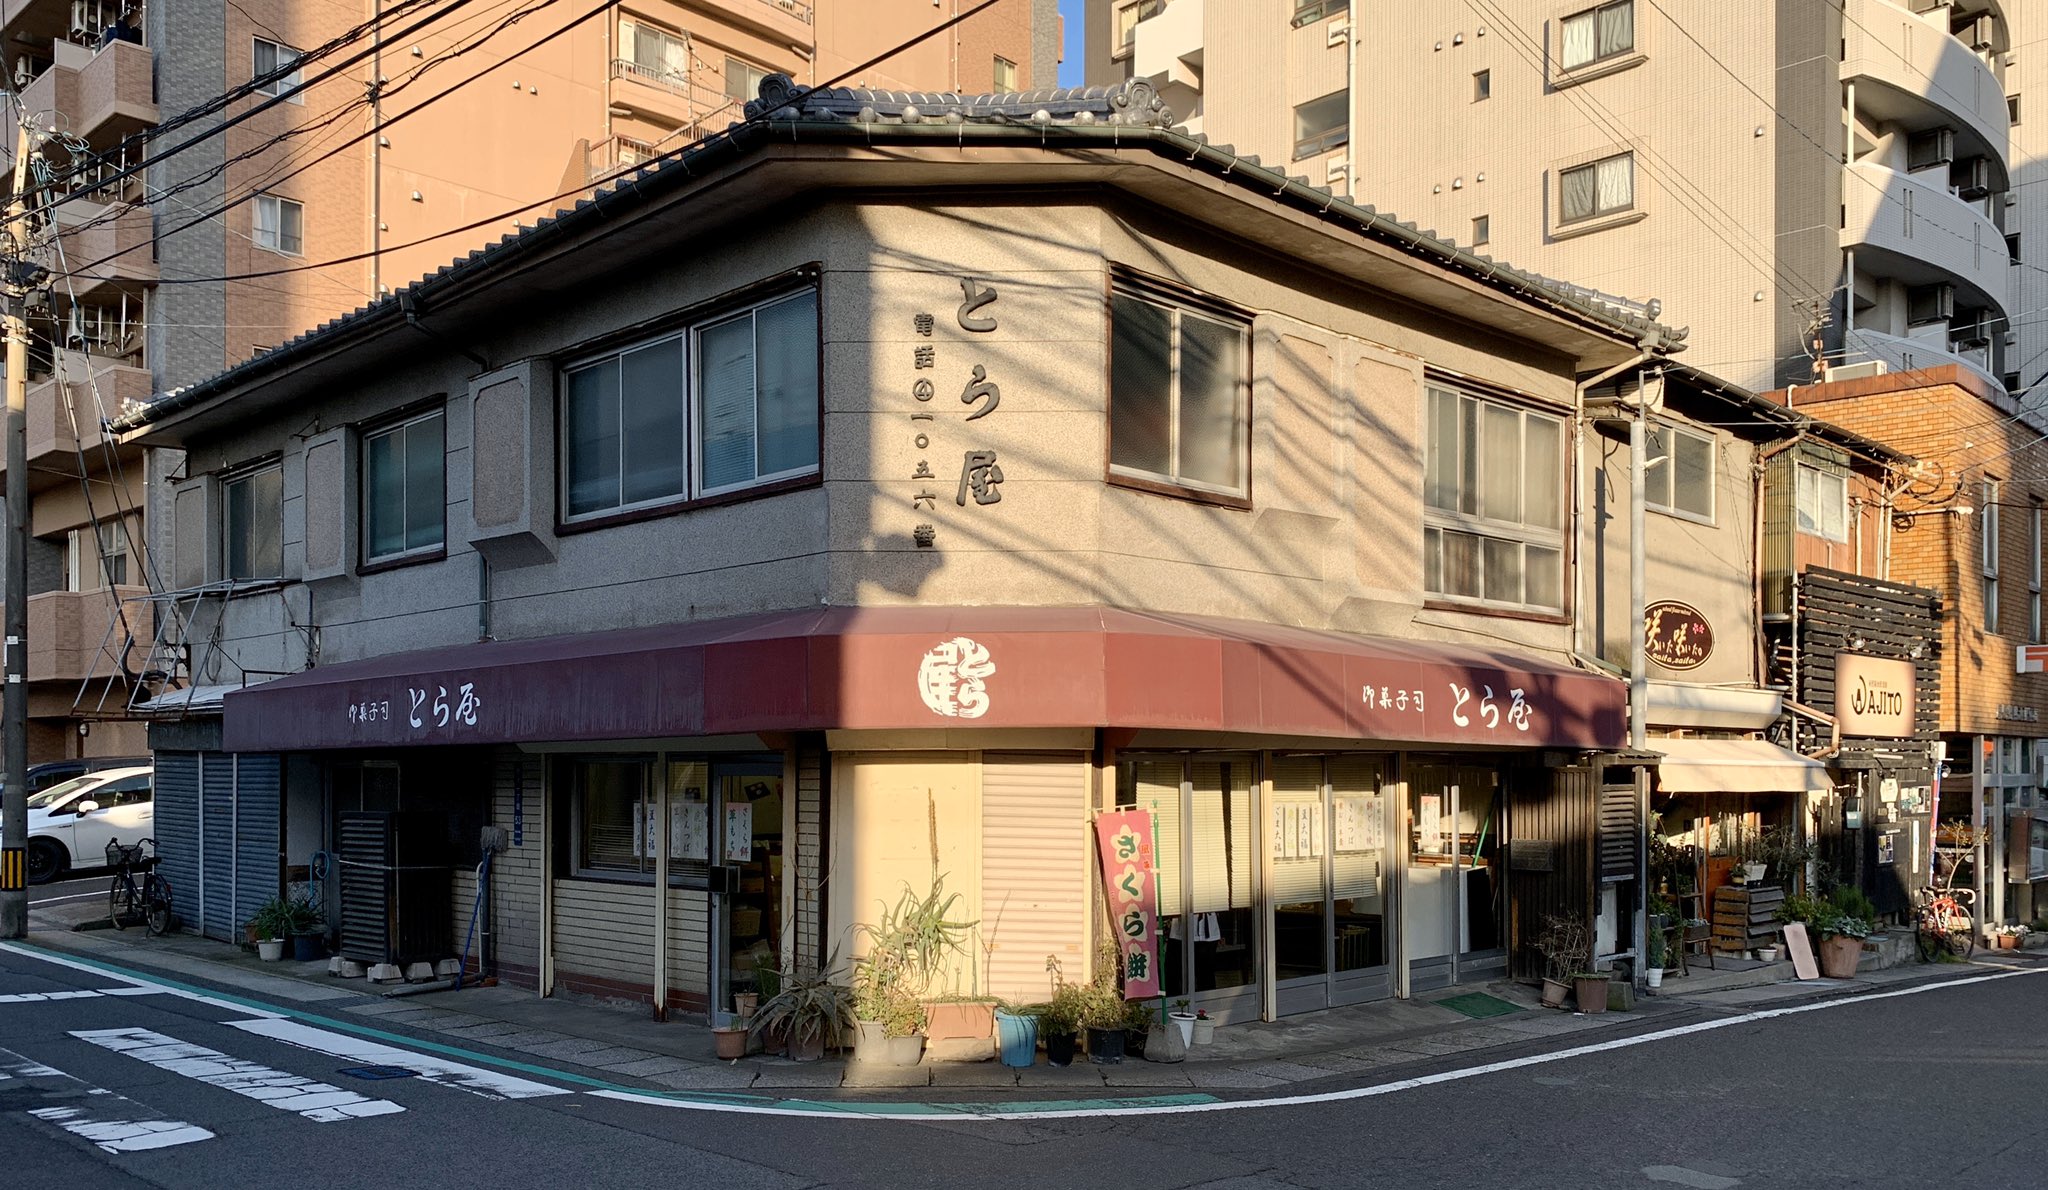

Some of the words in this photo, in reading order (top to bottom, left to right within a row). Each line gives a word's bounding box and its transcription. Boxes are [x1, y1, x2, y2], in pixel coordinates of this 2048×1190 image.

[956, 276, 1004, 507] とら屋
[408, 682, 481, 729] とら屋
[1449, 682, 1533, 731] とら屋
[1867, 690, 1902, 716] AJITO
[1117, 834, 1148, 980] さくら餅
